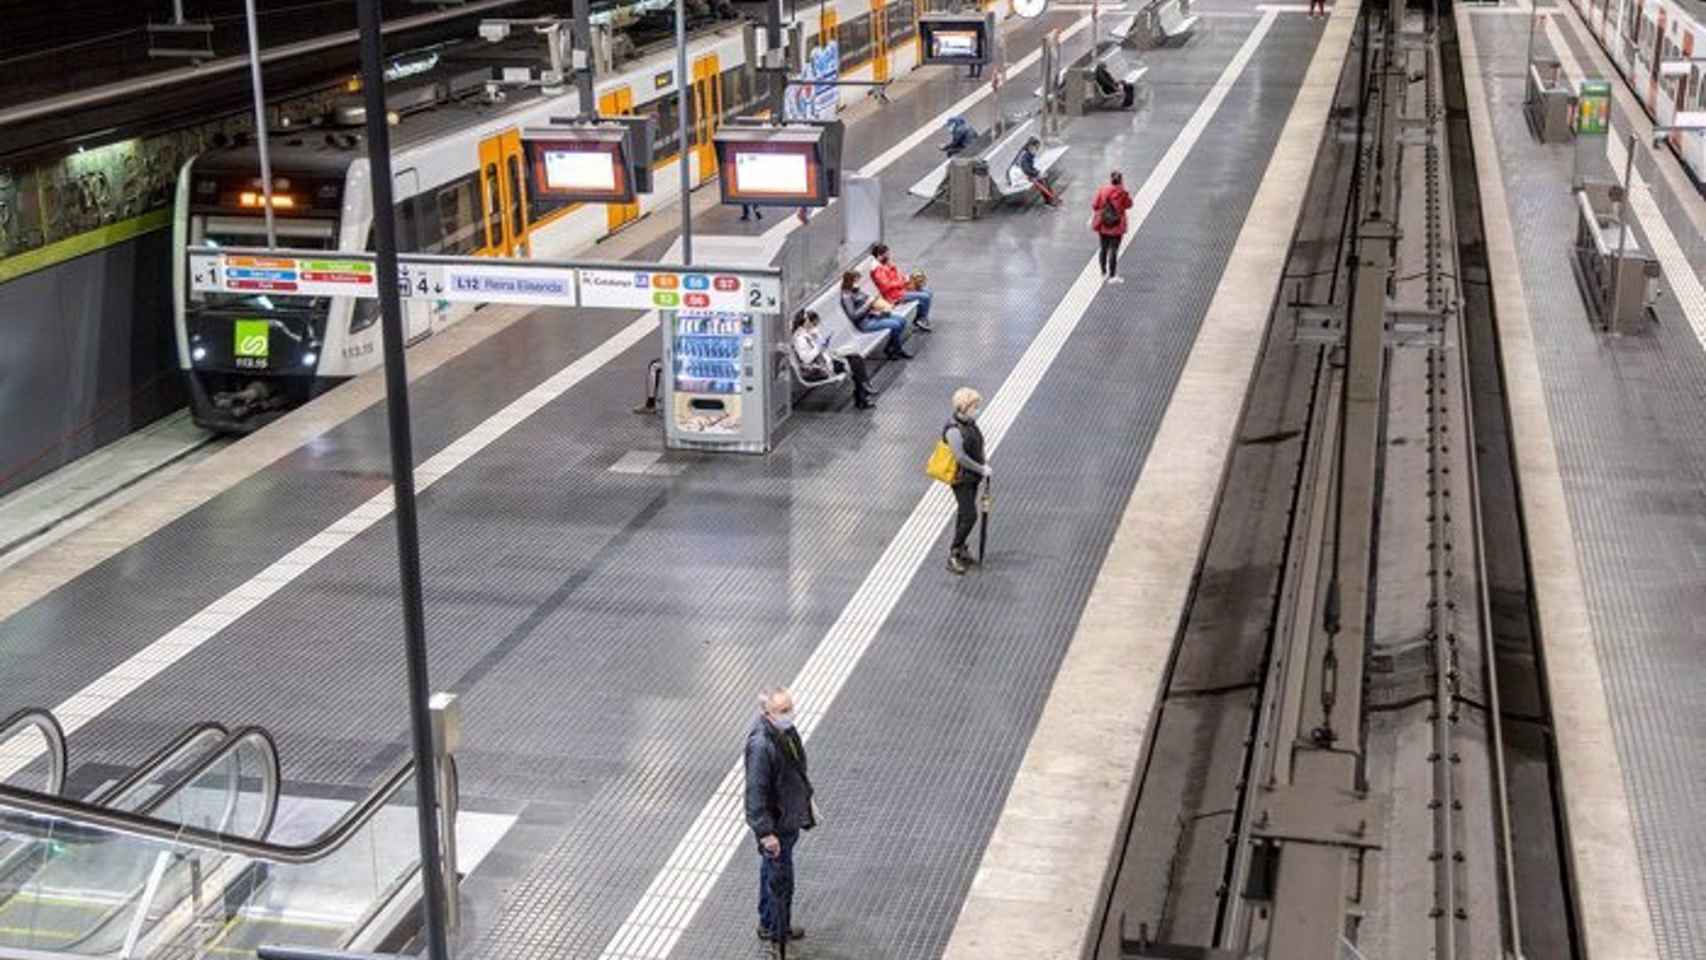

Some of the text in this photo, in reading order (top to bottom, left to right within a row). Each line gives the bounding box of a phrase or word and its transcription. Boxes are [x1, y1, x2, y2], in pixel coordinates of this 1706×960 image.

[208, 268, 217, 284] 1
[457, 276, 481, 290] L12
[418, 277, 430, 294] 4
[749, 289, 762, 307] 2
